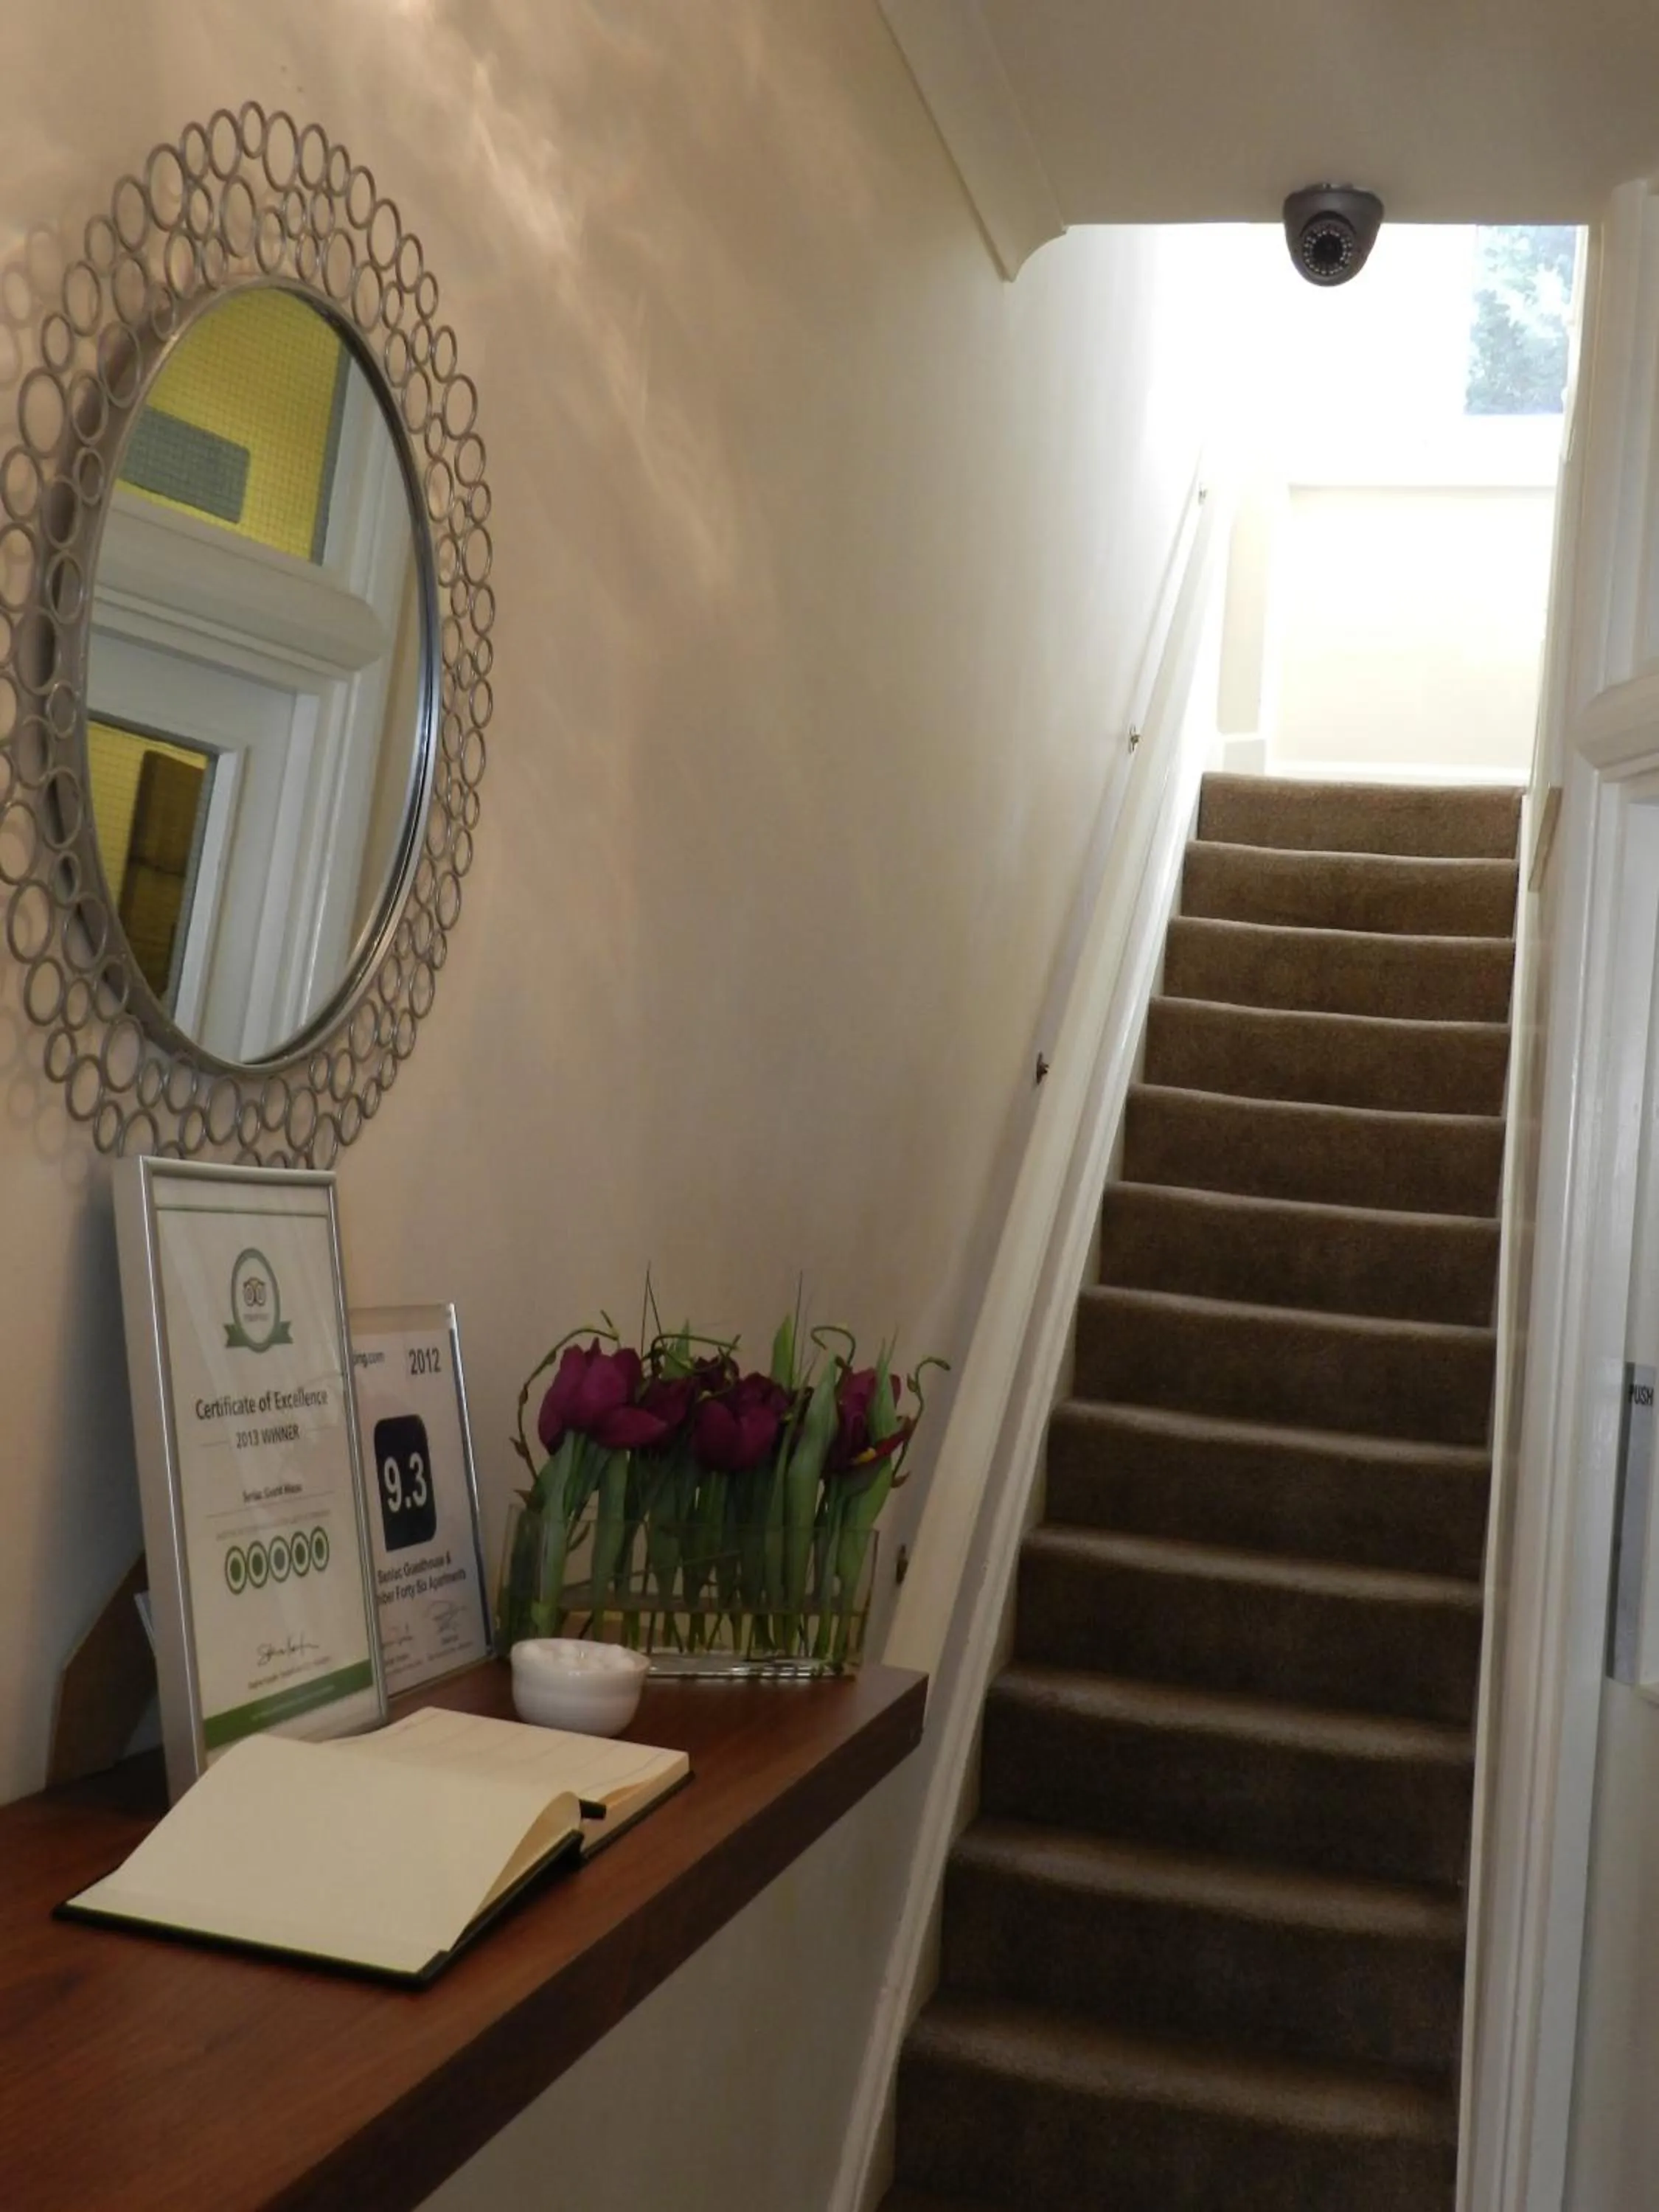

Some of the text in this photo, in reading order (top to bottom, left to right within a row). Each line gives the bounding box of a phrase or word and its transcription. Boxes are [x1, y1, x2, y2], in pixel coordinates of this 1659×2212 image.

[408, 1347, 442, 1375] 2012
[196, 1386, 329, 1420] Certificate of Excellence
[1629, 1384, 1654, 1405] PUSH
[235, 1424, 301, 1449] 2013 WINNER
[383, 1455, 428, 1513] 9.3
